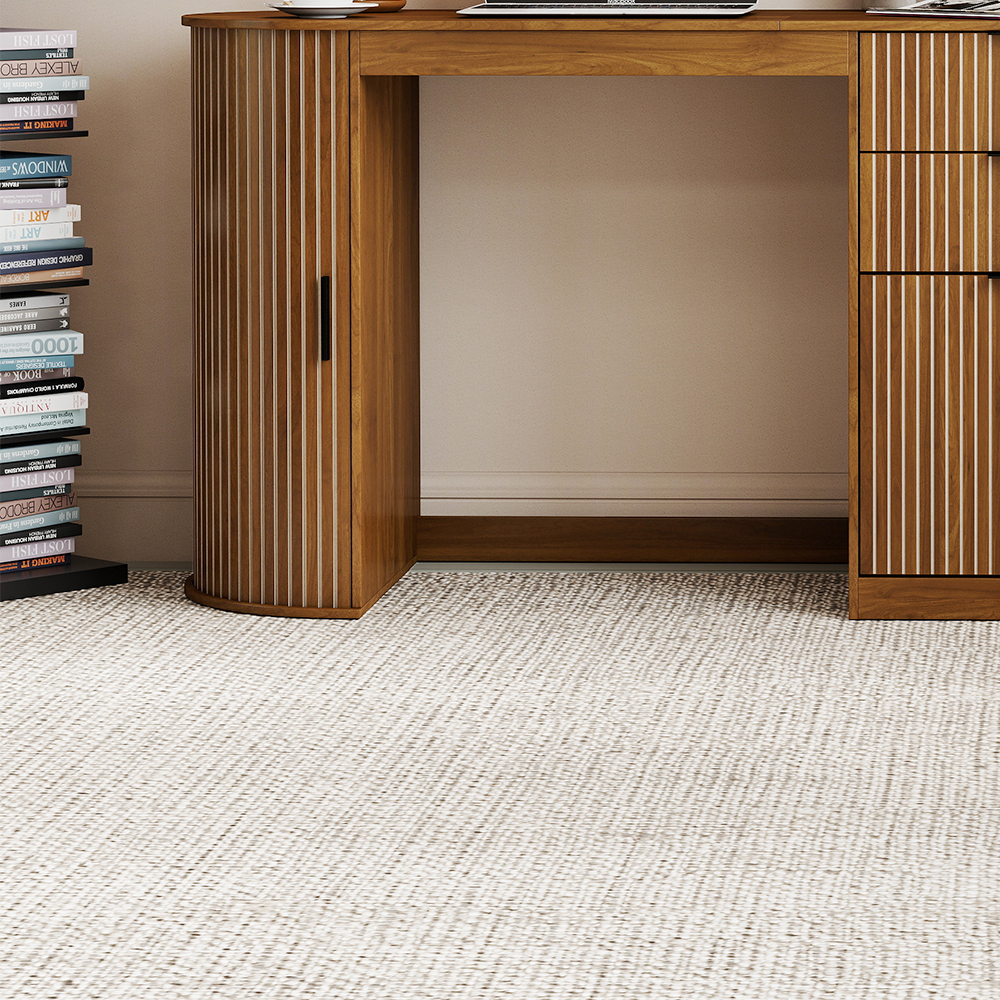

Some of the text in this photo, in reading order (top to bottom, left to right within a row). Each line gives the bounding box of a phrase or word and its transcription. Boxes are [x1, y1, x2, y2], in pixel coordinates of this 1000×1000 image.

[14, 34, 74, 46] LOST FISH
[32, 61, 79, 75] ALEXEY
[14, 104, 74, 118] LOST FISH
[34, 120, 68, 129] MAKING
[12, 160, 68, 176] WINDOWS
[28, 210, 50, 222] ART
[20, 227, 41, 239] ART
[37, 256, 57, 265] DESIGN
[59, 254, 83, 263] GRAPHIC
[32, 337, 78, 354] 1000
[12, 368, 42, 381] BOOK
[12, 449, 39, 457] Gardens
[11, 470, 71, 488] LOST FISH
[37, 493, 75, 511] ALEXEY
[21, 517, 45, 525] Gardens
[12, 539, 71, 558] LOST FISH
[21, 560, 30, 568] IT
[32, 555, 65, 567] MAKING
